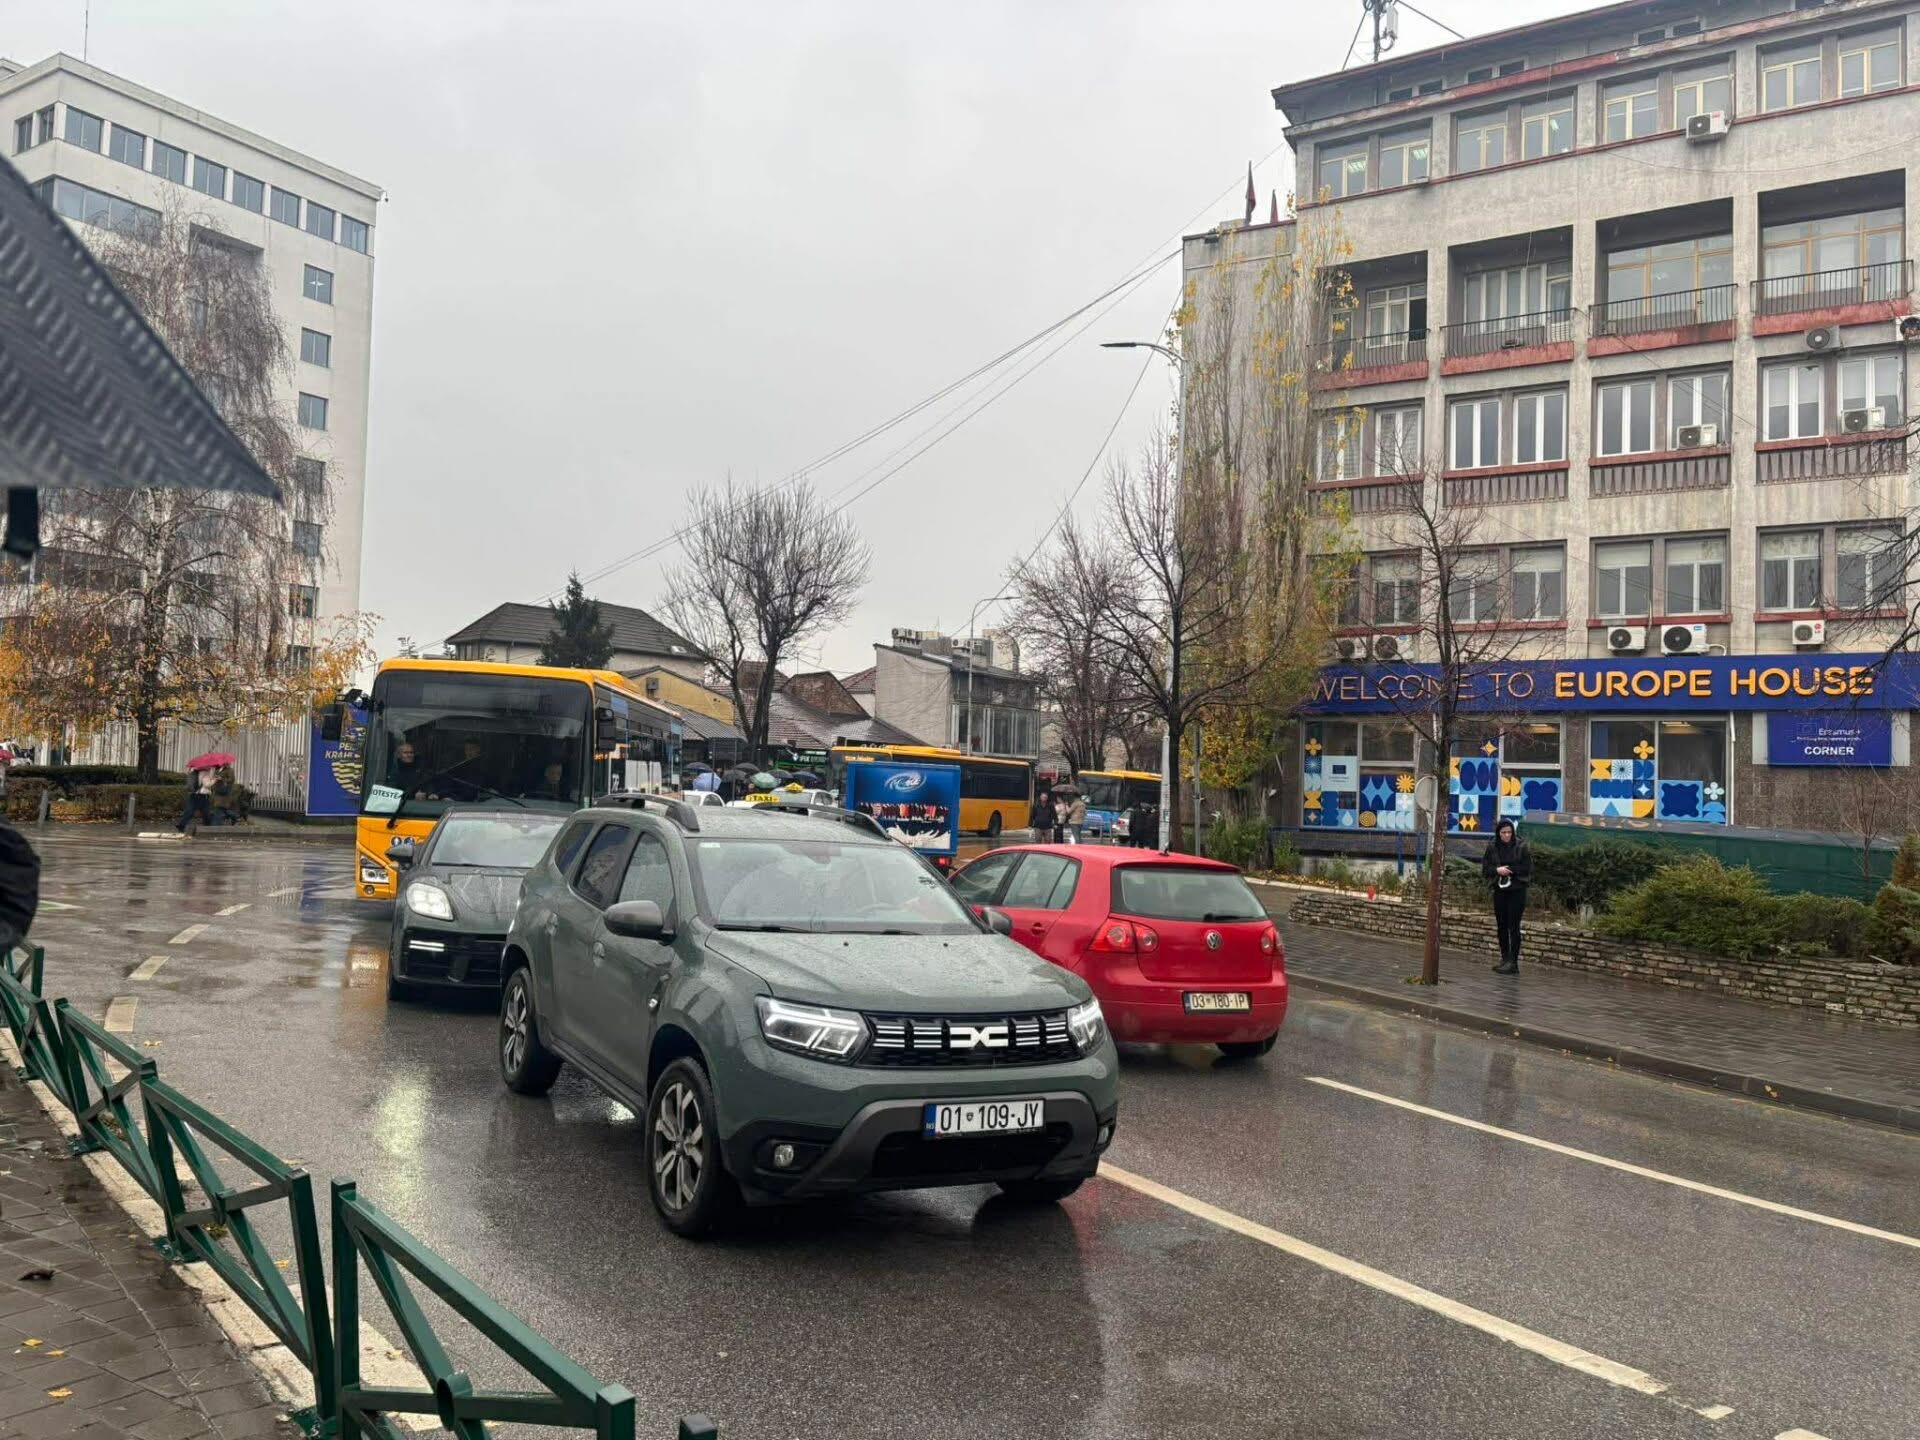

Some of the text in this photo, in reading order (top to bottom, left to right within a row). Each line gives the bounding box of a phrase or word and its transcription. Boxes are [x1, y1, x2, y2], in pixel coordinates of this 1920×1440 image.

[1488, 672, 1535, 698] TO
[1554, 668, 1713, 698] EUROPE
[1730, 666, 1875, 696] HOUSE
[1804, 746, 1854, 756] CORNER
